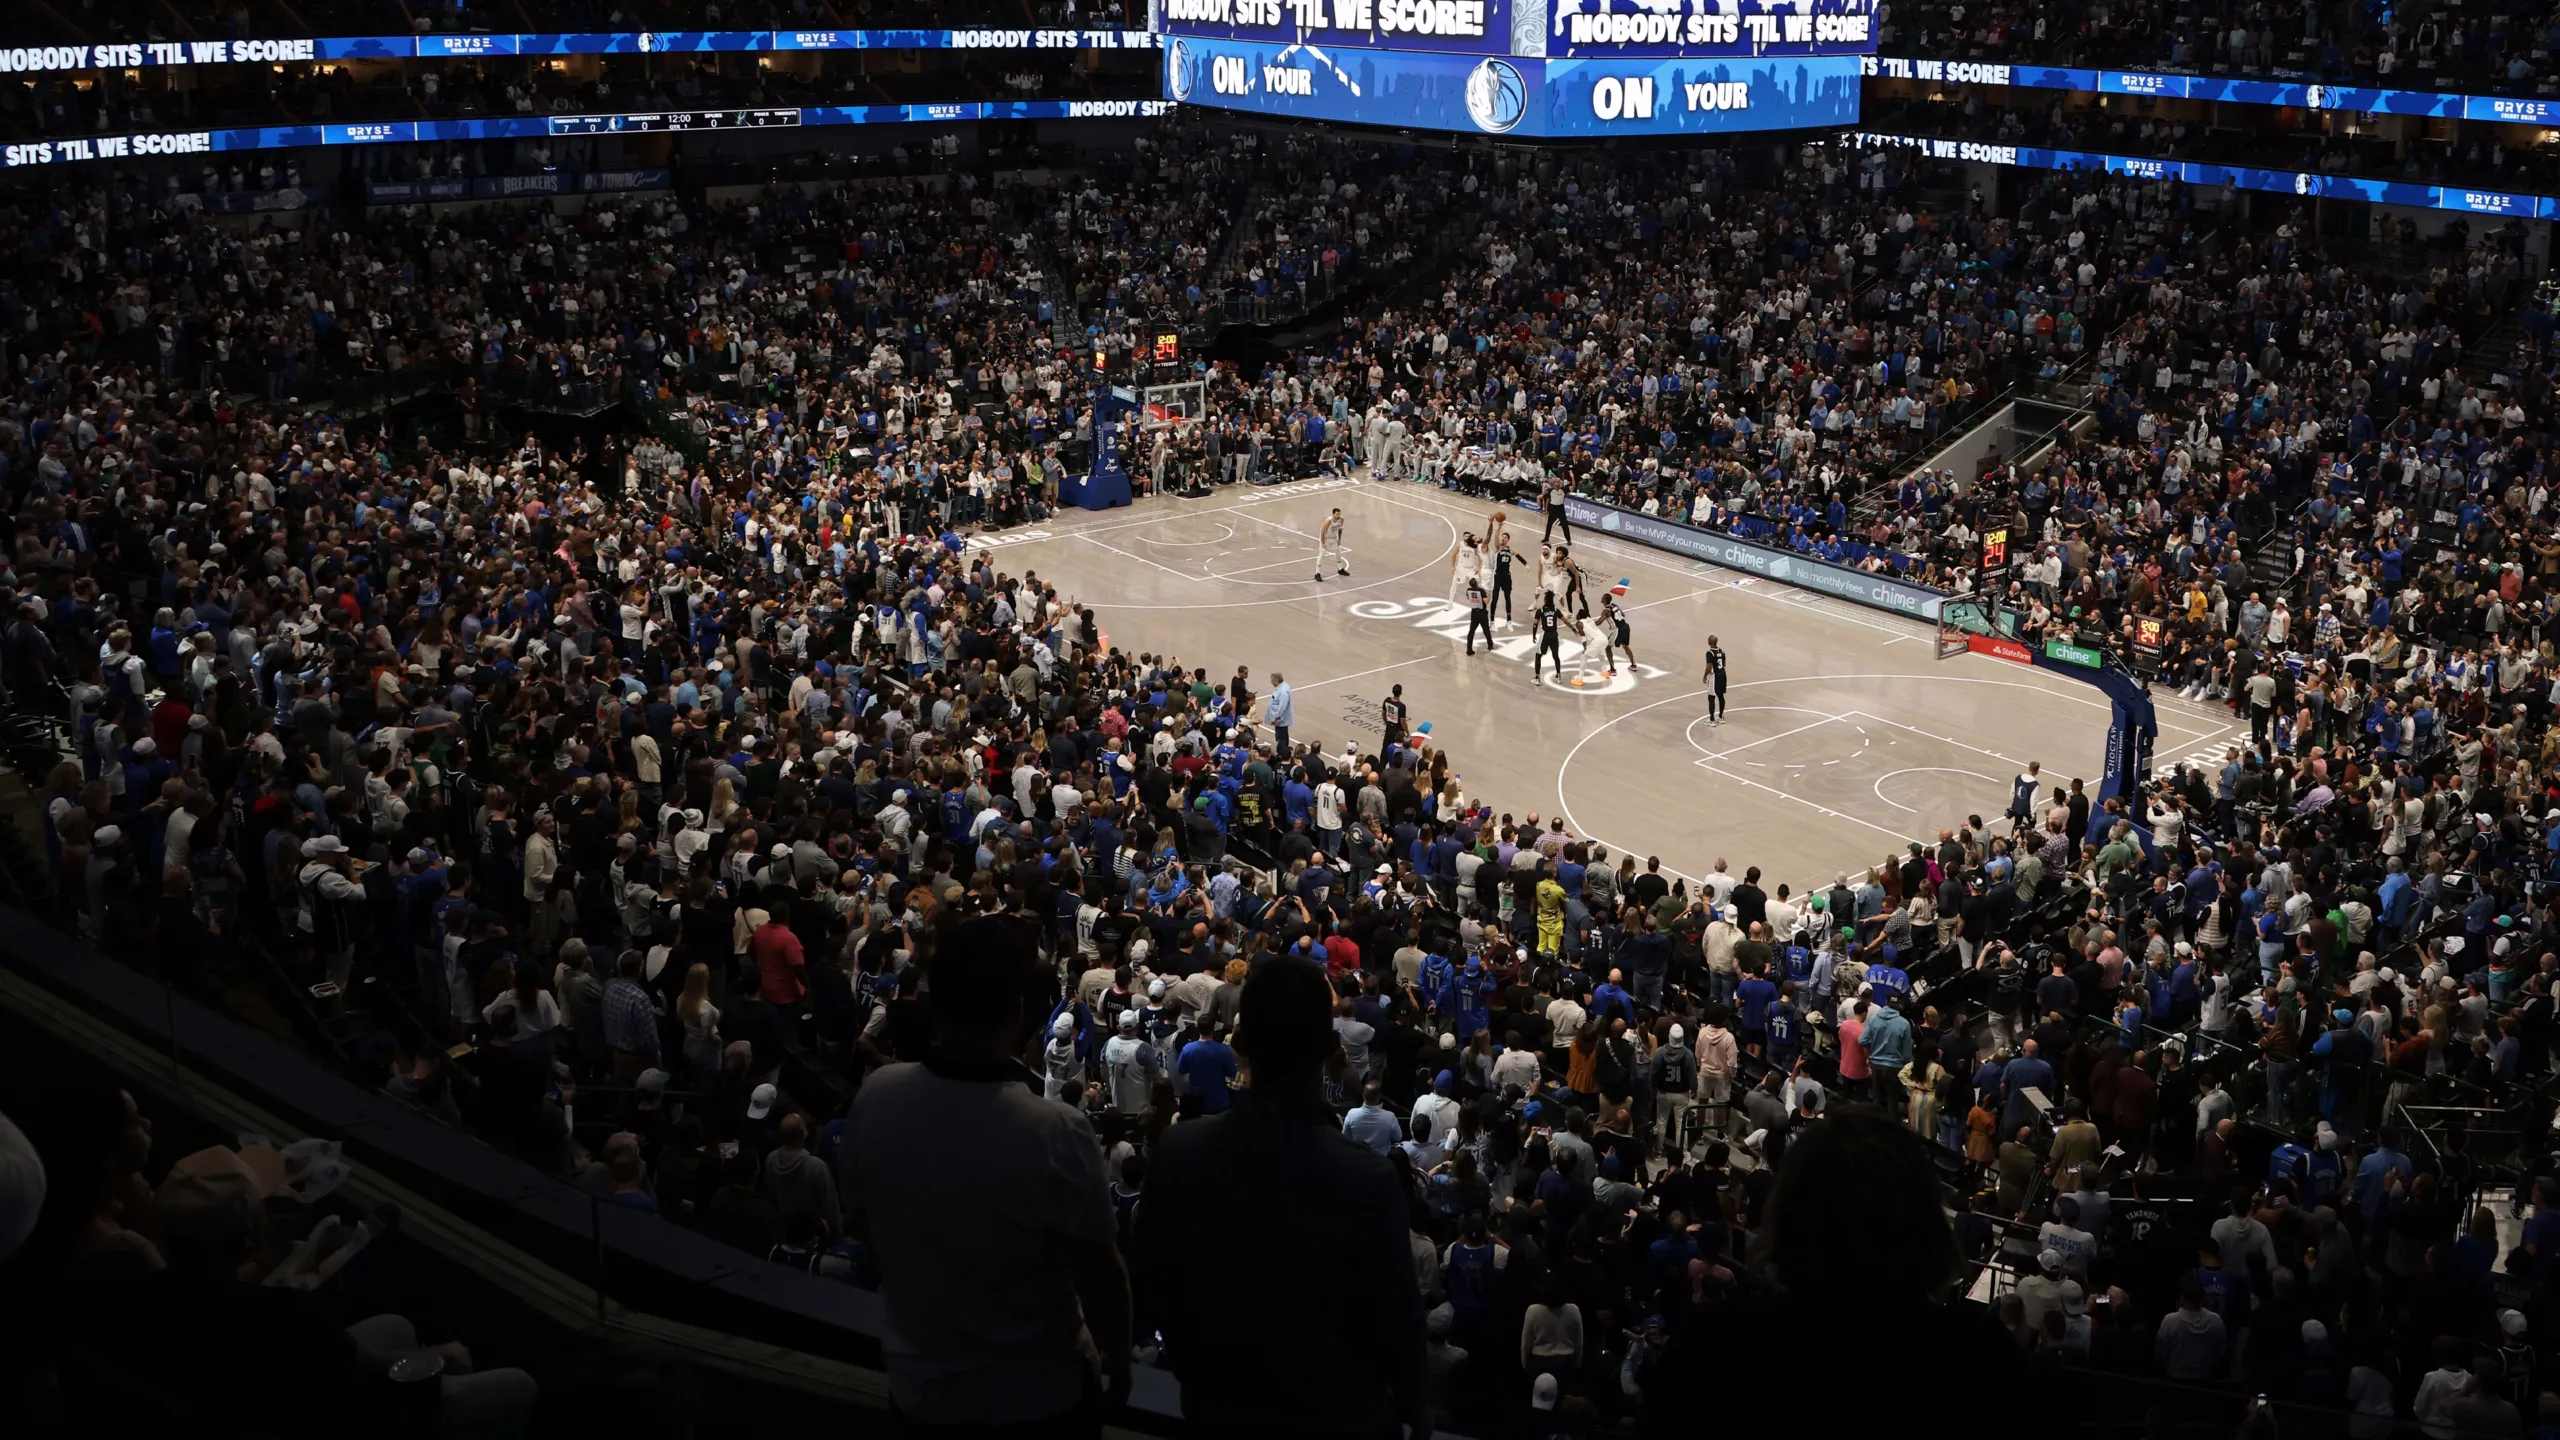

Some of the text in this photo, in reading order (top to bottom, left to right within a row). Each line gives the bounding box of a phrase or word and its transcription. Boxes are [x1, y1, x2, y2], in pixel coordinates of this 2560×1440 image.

[1168, 0, 1232, 23] NOBODY
[1237, 0, 1282, 26] SITS
[1334, 0, 1372, 30] WE
[1378, 0, 1485, 36] SCORE!
[1570, 13, 1683, 43] NOBODY
[1686, 13, 1739, 43] SITS
[1784, 14, 1813, 43] WE
[1815, 13, 1869, 42] SCORE!
[952, 30, 1032, 49] NOBODY
[1035, 30, 1079, 49] SITS
[1122, 31, 1151, 48] WE
[0, 46, 89, 73] NOBODY
[94, 43, 143, 68] SITS
[191, 42, 227, 63] WE
[233, 39, 314, 62] SCORE!
[1212, 55, 1312, 96] ON YOUR
[1916, 59, 1942, 80] WE
[1946, 62, 2010, 85] SCORE!
[1592, 76, 1749, 120] ON YOUR
[1069, 101, 1138, 117] NOBODY
[641, 122, 648, 130] 0
[668, 114, 691, 123] 12:00
[711, 119, 717, 128] 0
[758, 118, 765, 126] 0
[564, 124, 596, 133] 7 0
[5, 142, 53, 167] SITS
[96, 137, 129, 158] WE
[132, 132, 210, 156] SCORE!
[1933, 140, 1957, 159] WE
[1960, 142, 2017, 165] SCORE!
[503, 174, 558, 195] BREAKERS
[1158, 335, 1177, 345] 12:00
[1156, 344, 1175, 360] 24
[1987, 530, 2007, 545] 12:00
[1564, 502, 1597, 524] chime
[1625, 521, 1635, 532] Be
[1635, 523, 1648, 536] the
[1649, 527, 1667, 541] MVP
[1667, 532, 1675, 542] of
[1674, 536, 1692, 549] your
[1725, 545, 1765, 569] chime
[1797, 568, 1809, 580] No
[1810, 573, 1845, 592] monthly
[1872, 583, 1916, 610] chime
[1984, 543, 2005, 567] 24
[1990, 568, 2007, 578] TISSOT
[1546, 616, 1554, 627] 5
[2141, 630, 2156, 643] 24
[2002, 647, 2031, 661] State Farm
[2056, 645, 2090, 663] chime
[1717, 658, 1723, 669] 3
[2107, 726, 2117, 777] CHOCTAW
[949, 809, 960, 824] 31
[1079, 922, 1091, 937] 77
[860, 990, 875, 1008] 77
[1107, 1001, 1125, 1011] CARTER
[1771, 1021, 1787, 1039] 77
[1665, 1064, 1681, 1083] 31
[2125, 1209, 2160, 1222] YAMAMOTO
[2131, 1221, 2151, 1241] 18
